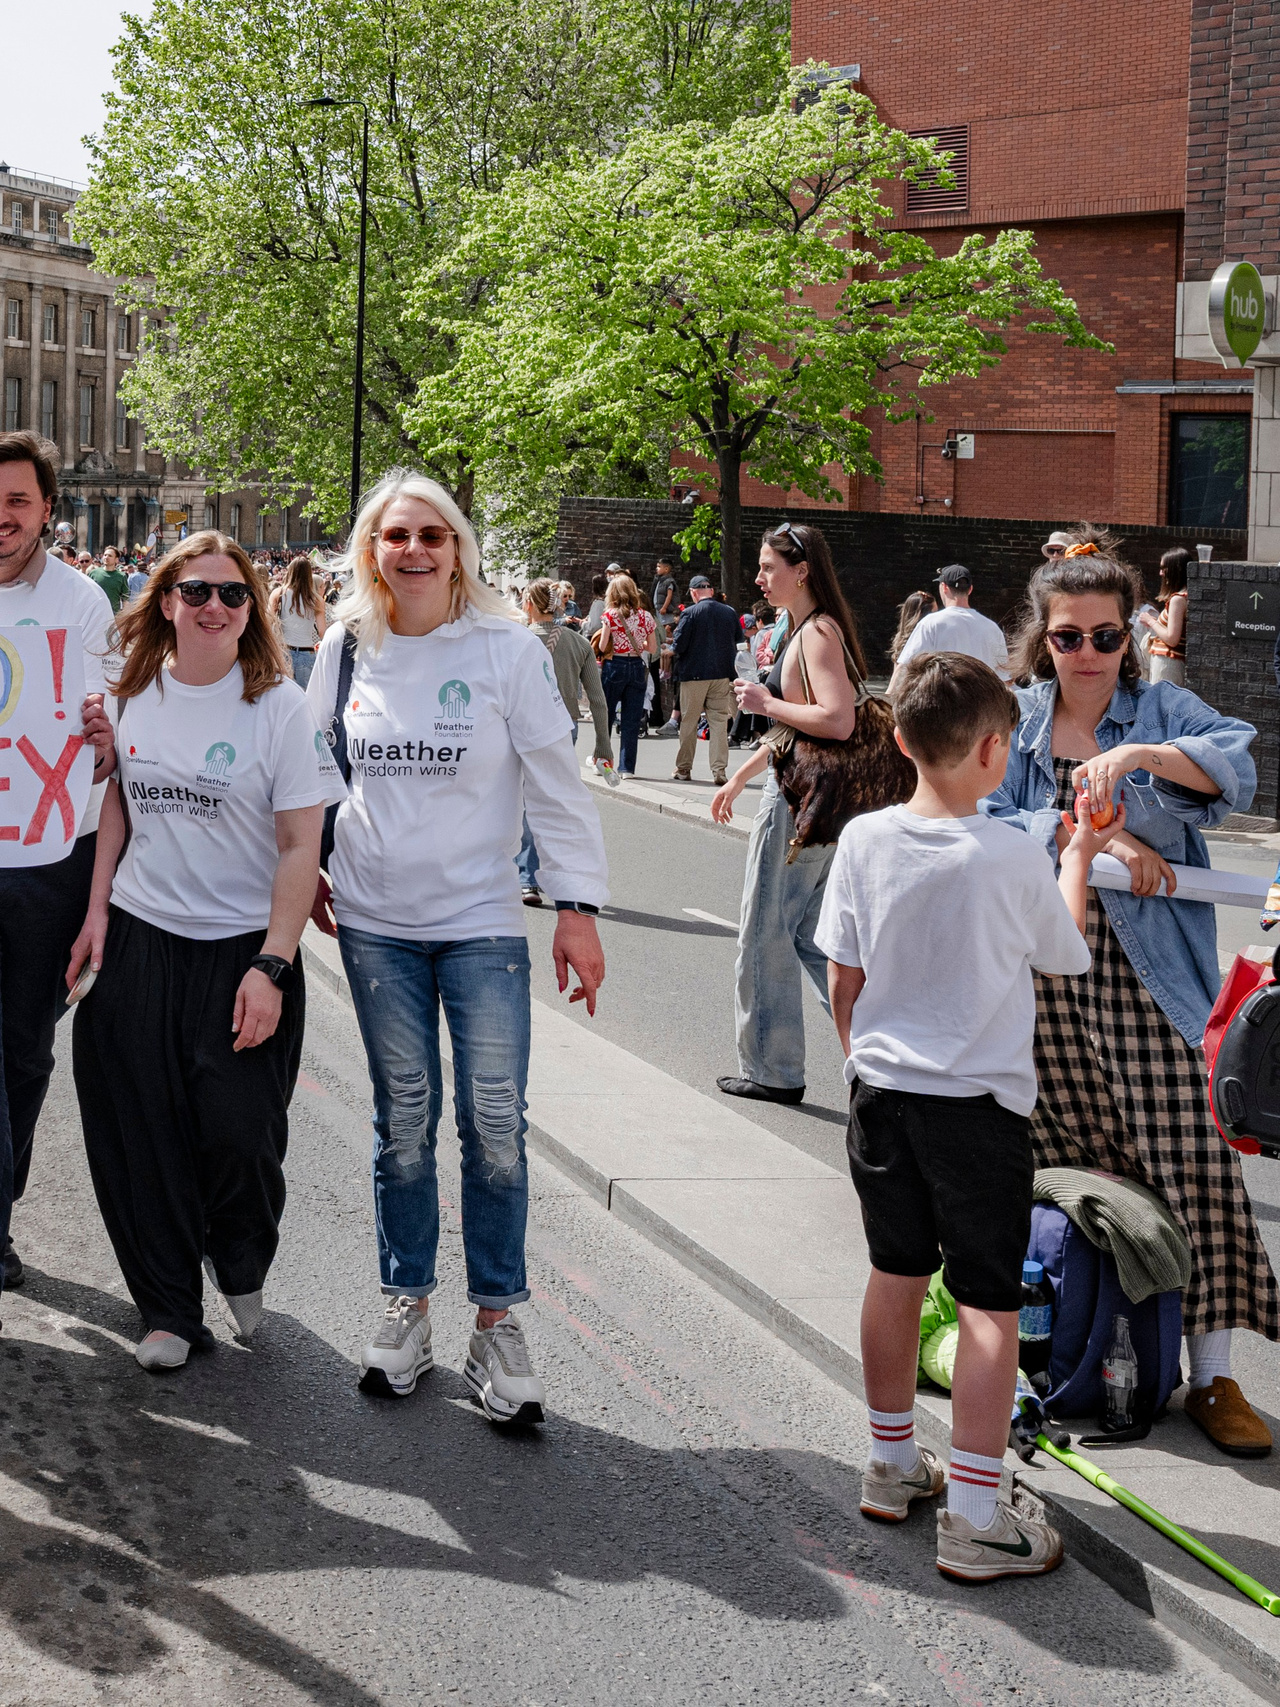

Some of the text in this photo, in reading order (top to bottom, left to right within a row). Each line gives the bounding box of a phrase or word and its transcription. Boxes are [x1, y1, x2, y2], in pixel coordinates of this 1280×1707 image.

[1231, 287, 1258, 319] hub
[1235, 621, 1275, 631] Reception
[434, 722, 474, 731] Weather
[349, 738, 467, 762] Weather
[419, 764, 457, 776] wins
[196, 774, 231, 788] Weather
[196, 782, 229, 793] Foundation
[128, 781, 222, 808] Weather
[136, 802, 218, 819] Wisdom wins
